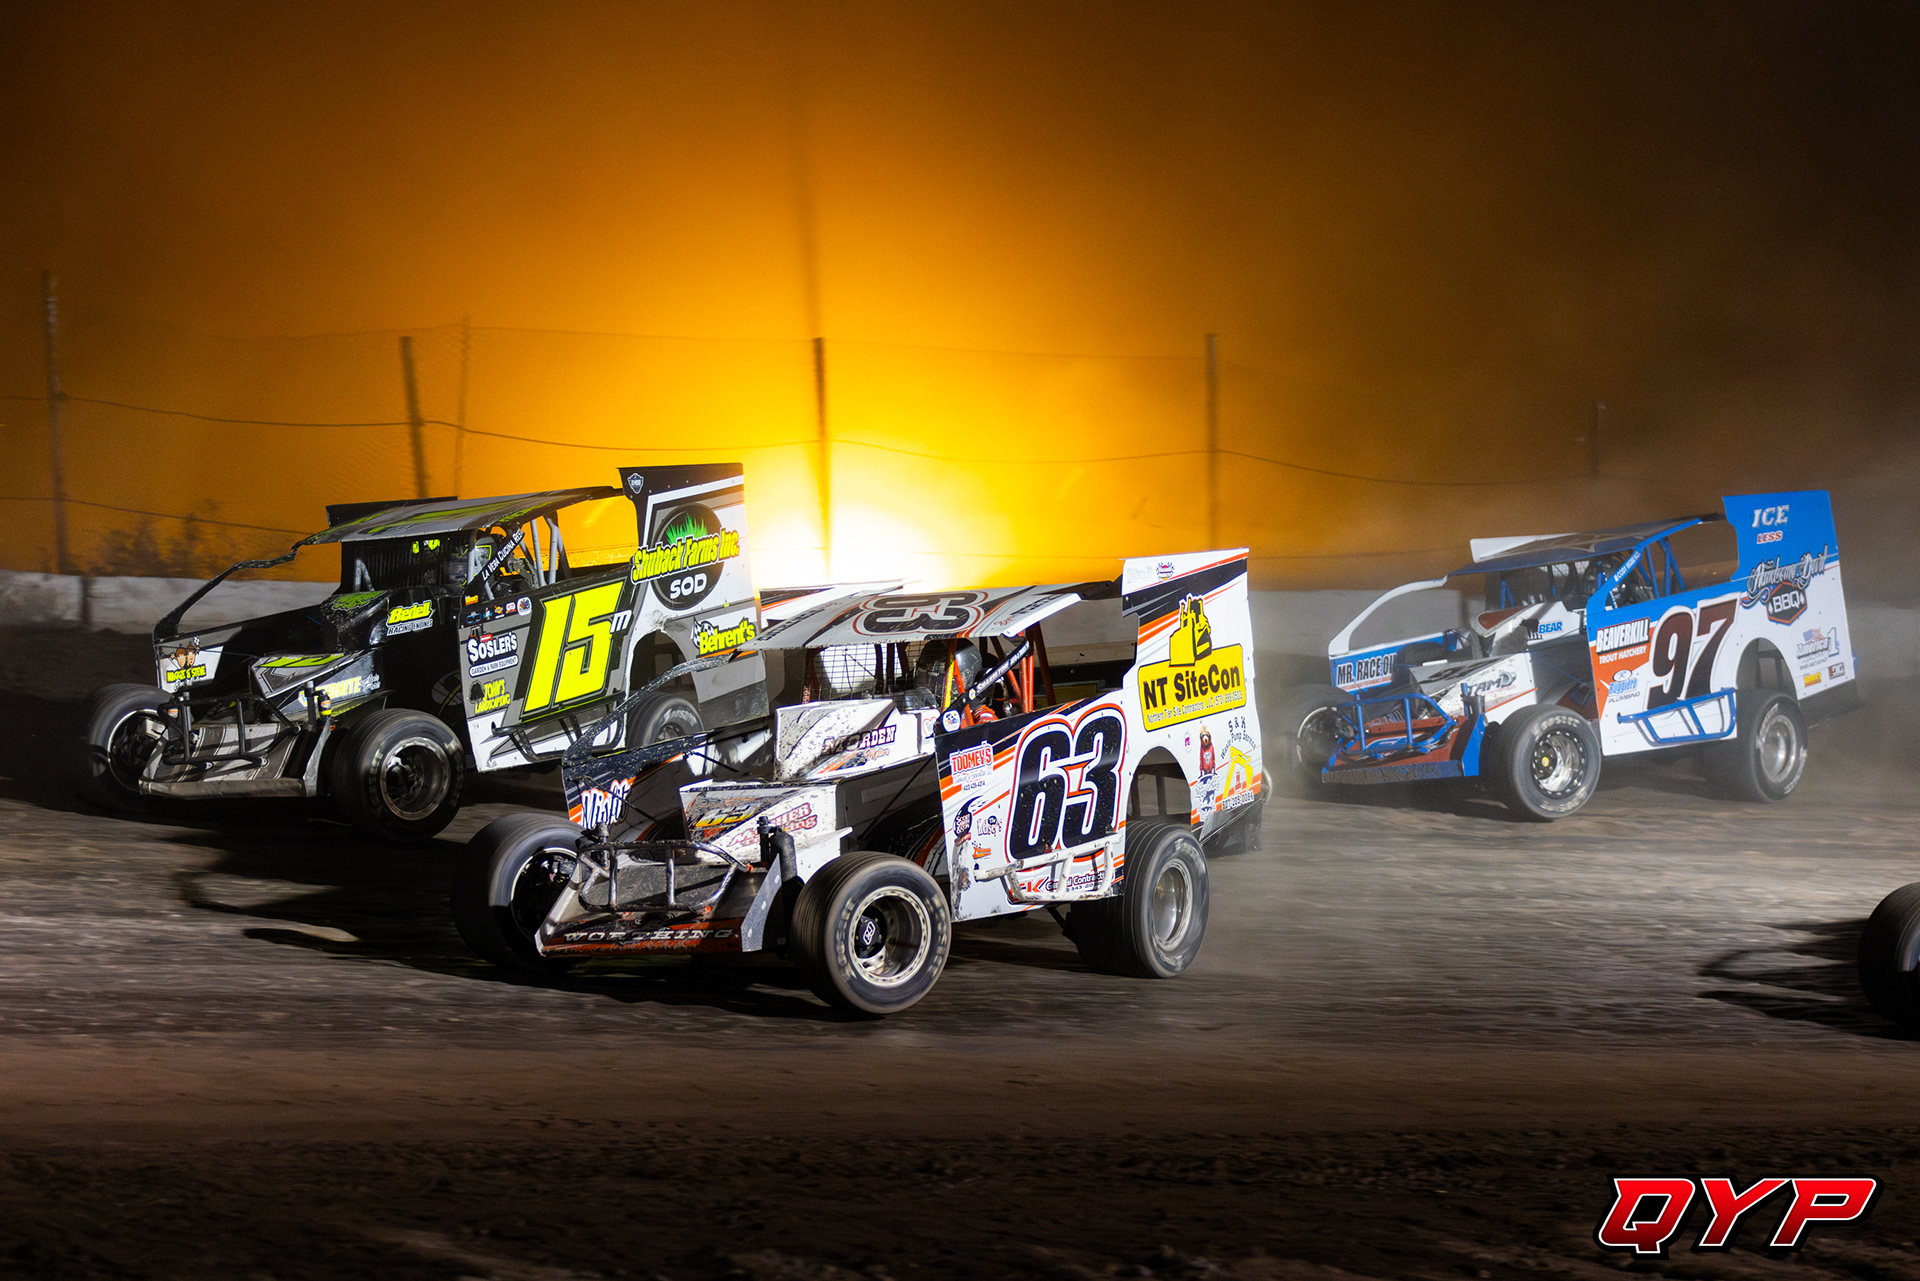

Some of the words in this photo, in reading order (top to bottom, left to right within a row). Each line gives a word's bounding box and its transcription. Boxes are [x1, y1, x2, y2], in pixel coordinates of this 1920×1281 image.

[1752, 505, 1790, 528] ICE
[1757, 531, 1783, 544] LESS
[631, 541, 686, 583] Shuback
[682, 535, 720, 569] Farms
[718, 528, 740, 560] Inc.
[669, 573, 707, 599] SOD
[387, 601, 431, 624] Bedell
[1772, 591, 1800, 613] BBQ
[700, 620, 756, 655] Behrent's
[1539, 622, 1563, 634] BEAR
[1596, 618, 1650, 654] BEAVERKILL
[1599, 652, 1619, 664] TROUT
[1647, 597, 1738, 711] 97
[1337, 664, 1355, 685] MR.
[1356, 656, 1382, 680] RACE
[1143, 676, 1168, 710] NT
[1173, 664, 1241, 702] SiteCon
[1007, 710, 1125, 862] 63
[563, 929, 734, 942] WORTHING
